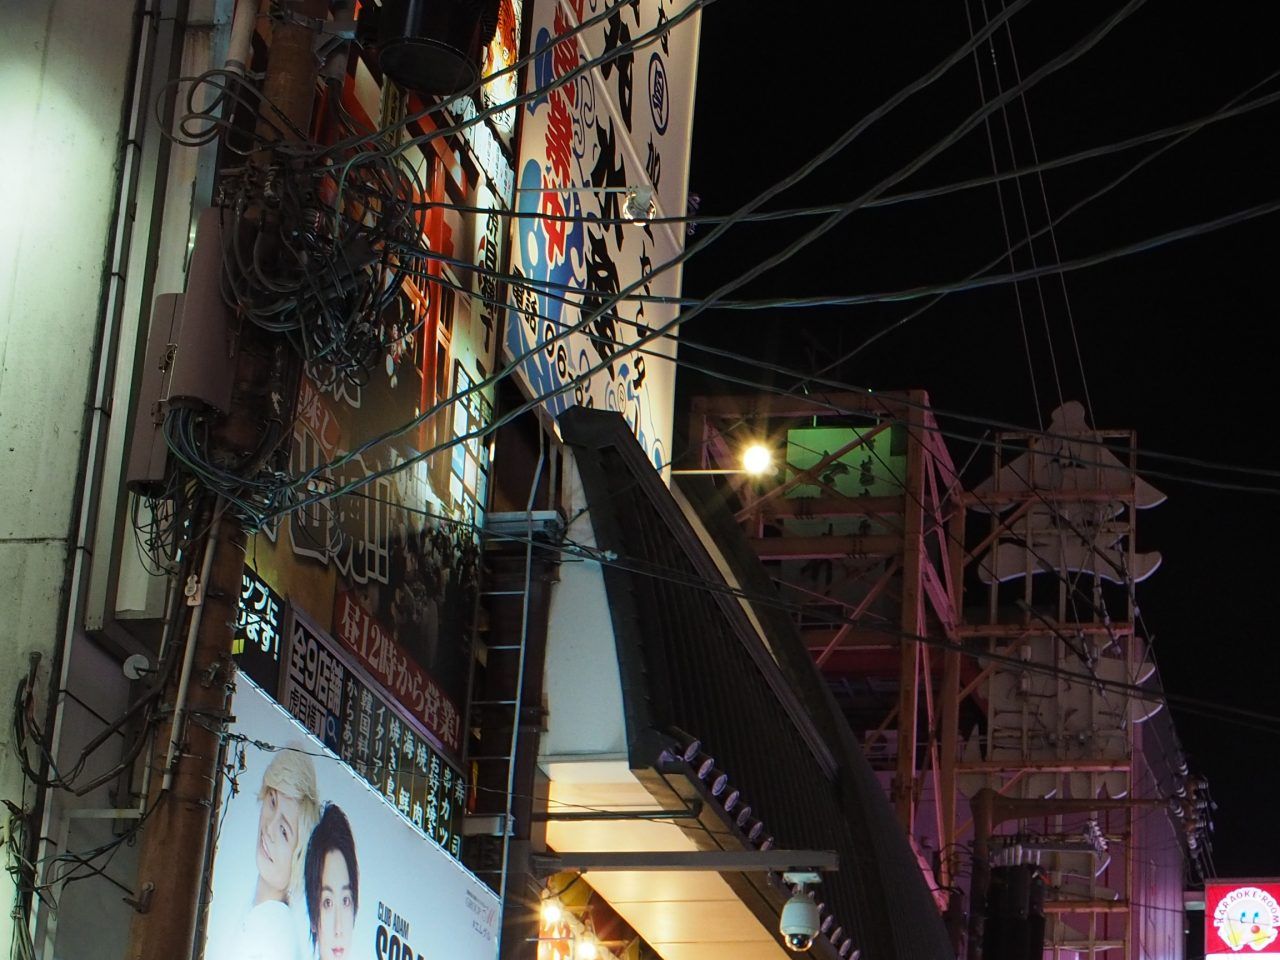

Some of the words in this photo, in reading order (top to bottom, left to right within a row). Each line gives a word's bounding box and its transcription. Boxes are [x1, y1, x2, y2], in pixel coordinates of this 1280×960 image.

[290, 620, 344, 718] 全9店舗
[412, 740, 428, 829] 焼肉
[376, 901, 392, 928] CLUB
[392, 911, 410, 941] ADAM
